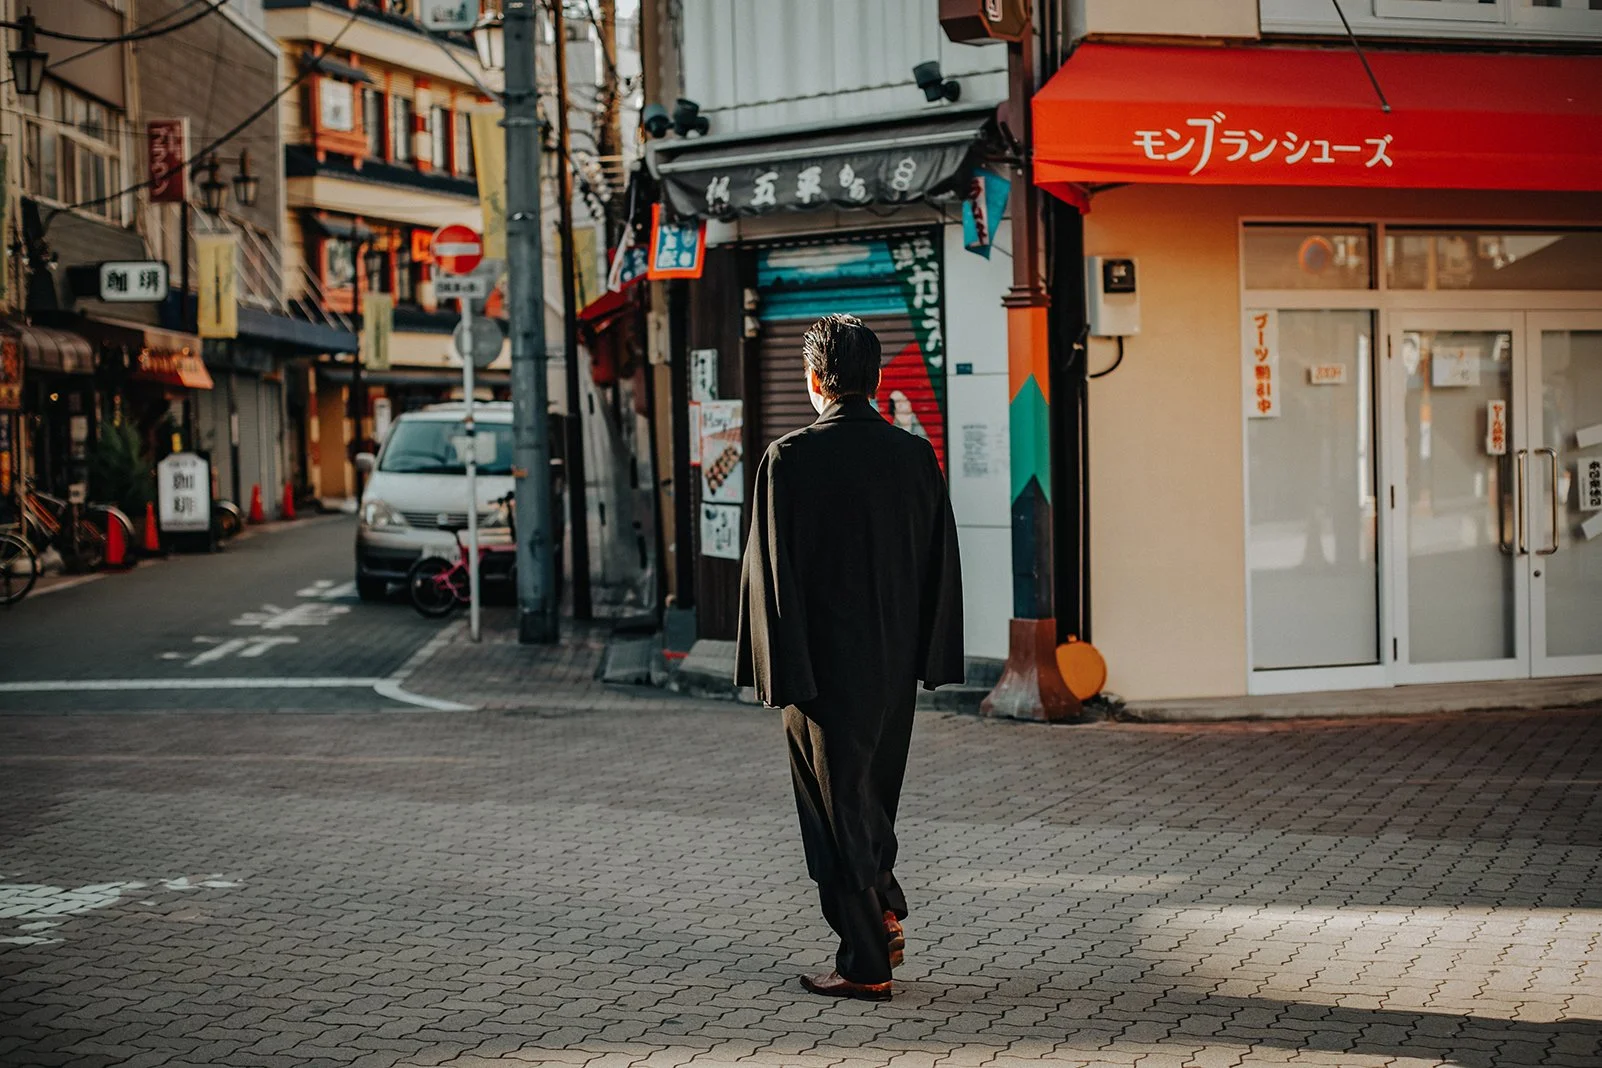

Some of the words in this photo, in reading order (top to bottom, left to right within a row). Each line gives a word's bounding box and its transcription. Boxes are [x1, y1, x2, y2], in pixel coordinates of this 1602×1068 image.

[1132, 110, 1393, 176] モンブランシューズ
